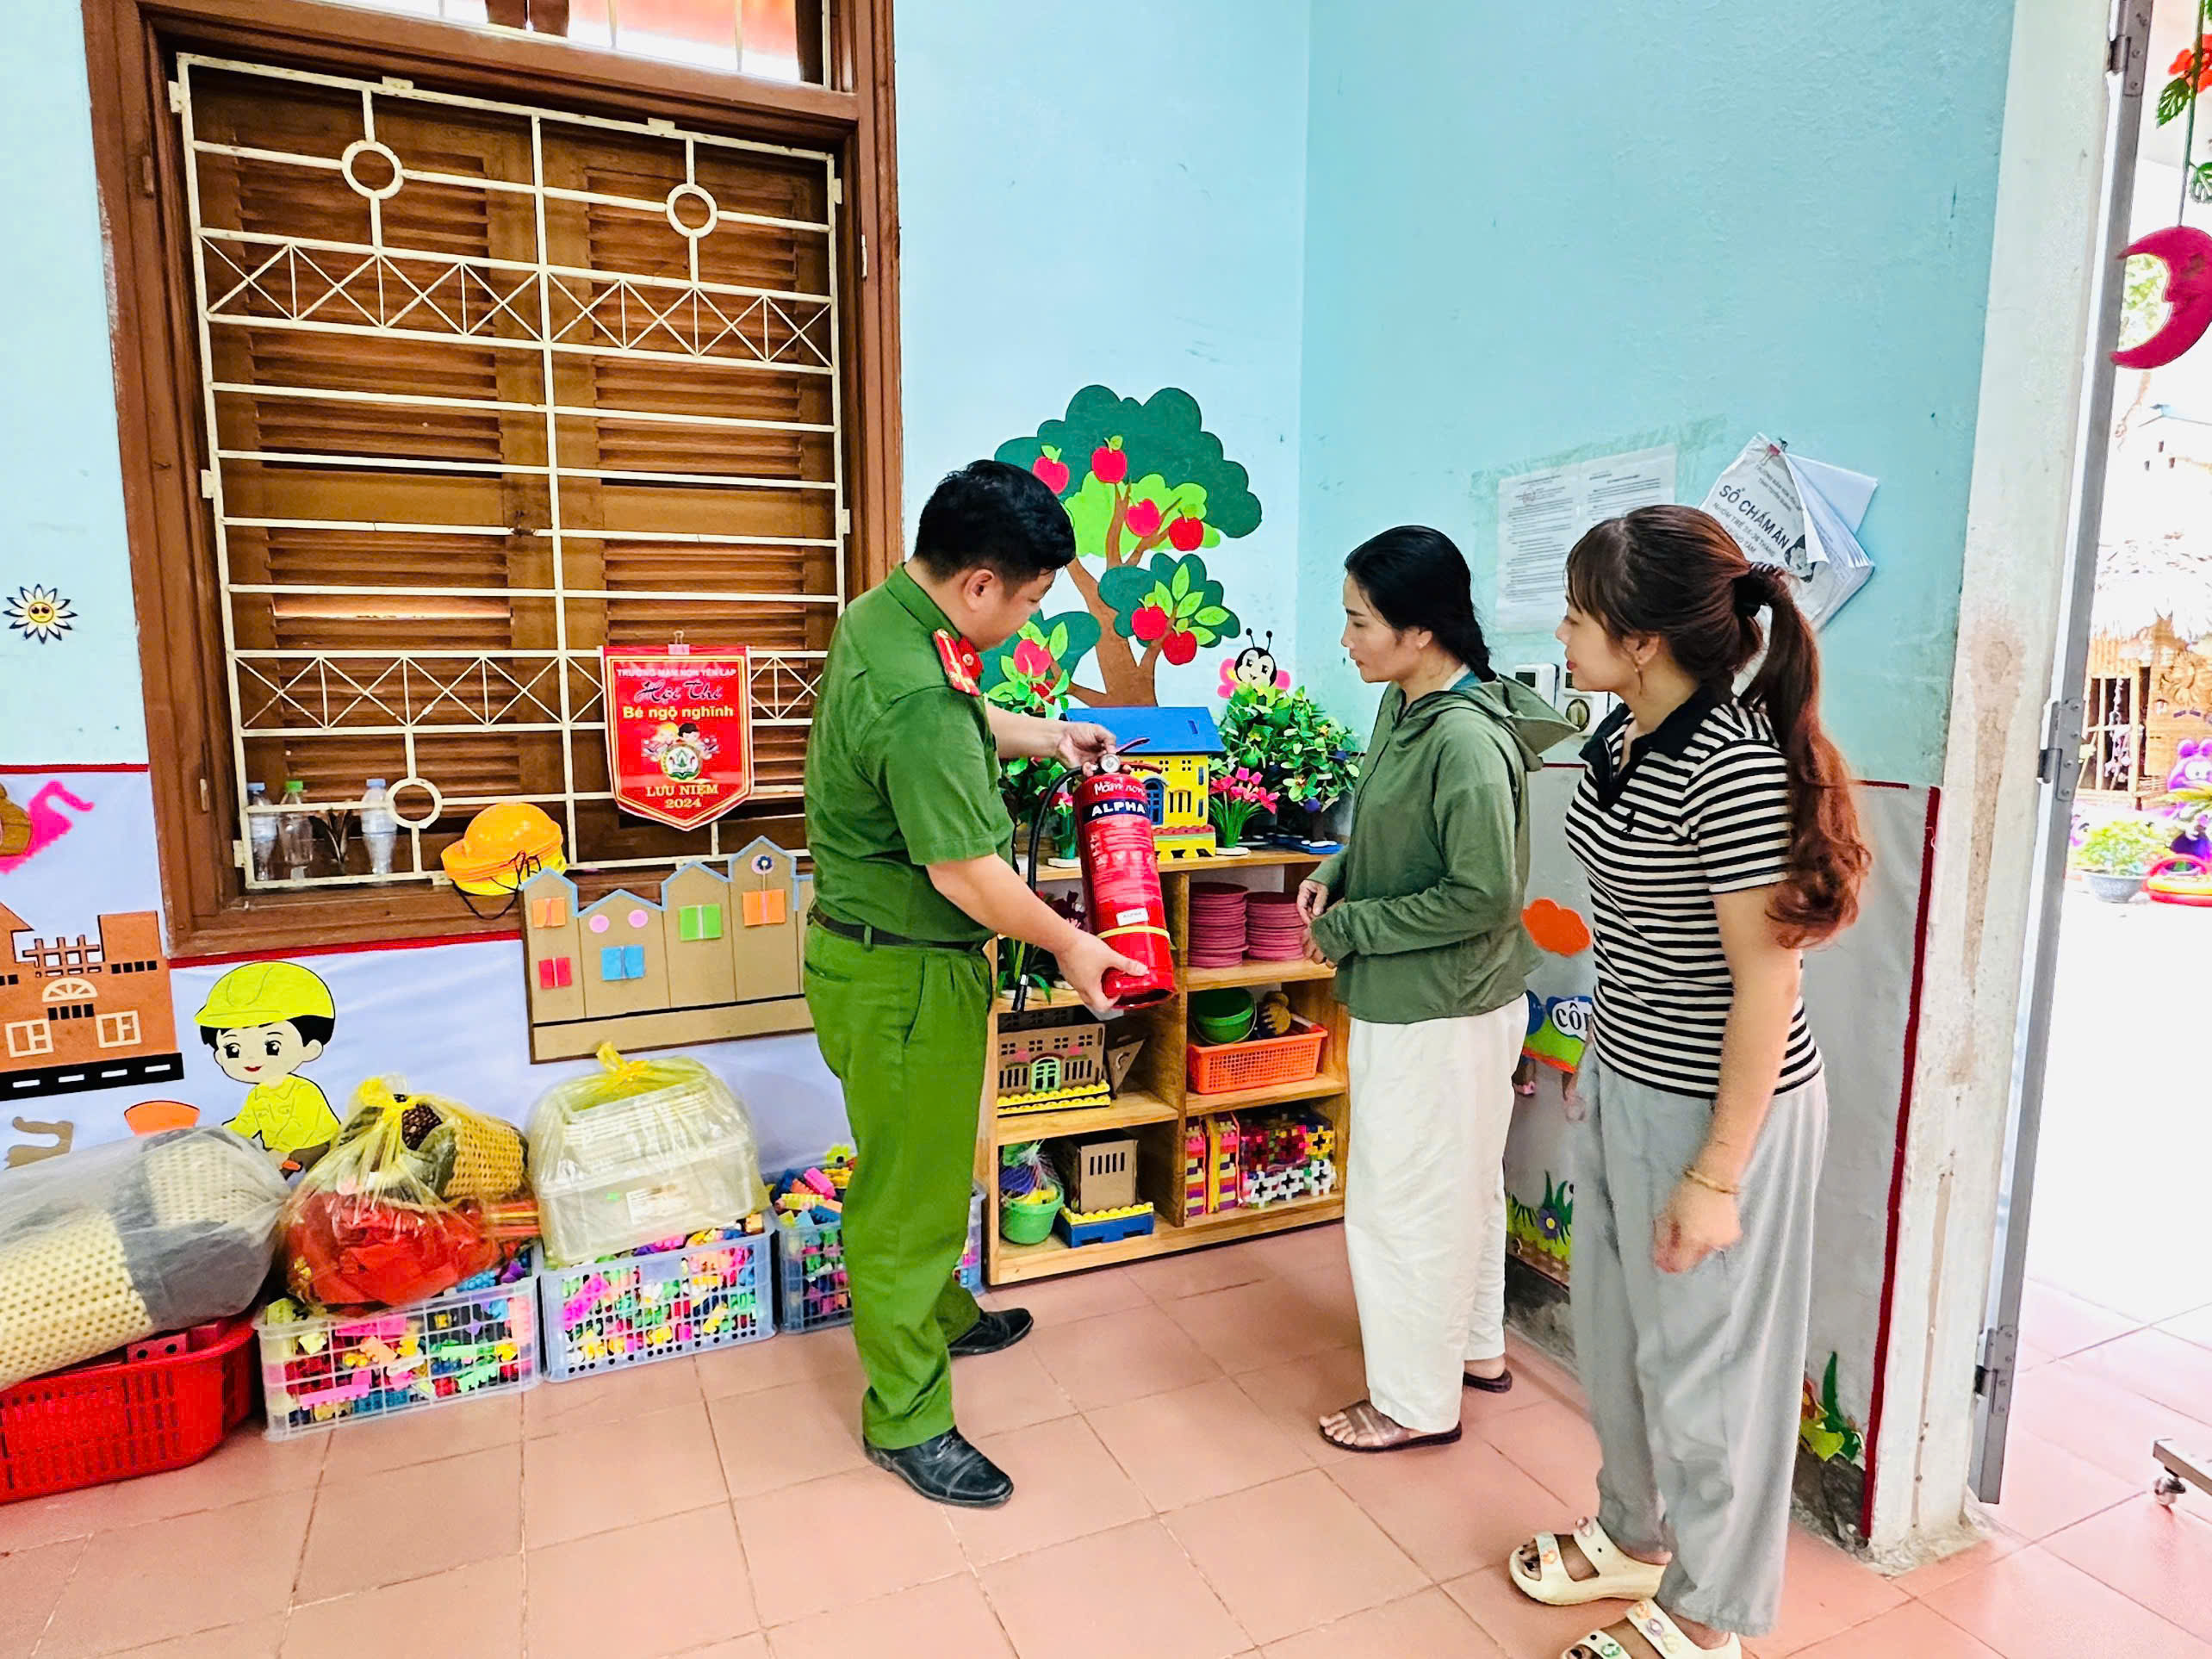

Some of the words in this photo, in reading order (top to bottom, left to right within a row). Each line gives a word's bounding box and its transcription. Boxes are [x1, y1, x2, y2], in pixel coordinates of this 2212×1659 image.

[1771, 527, 1790, 550] ĂN
[634, 680, 682, 703] Hội
[623, 706, 643, 718] Bé
[682, 705, 734, 720] nghĩnh
[646, 785, 675, 797] LƯU
[664, 798, 702, 809] 2024
[1091, 801, 1146, 817] ALPHA
